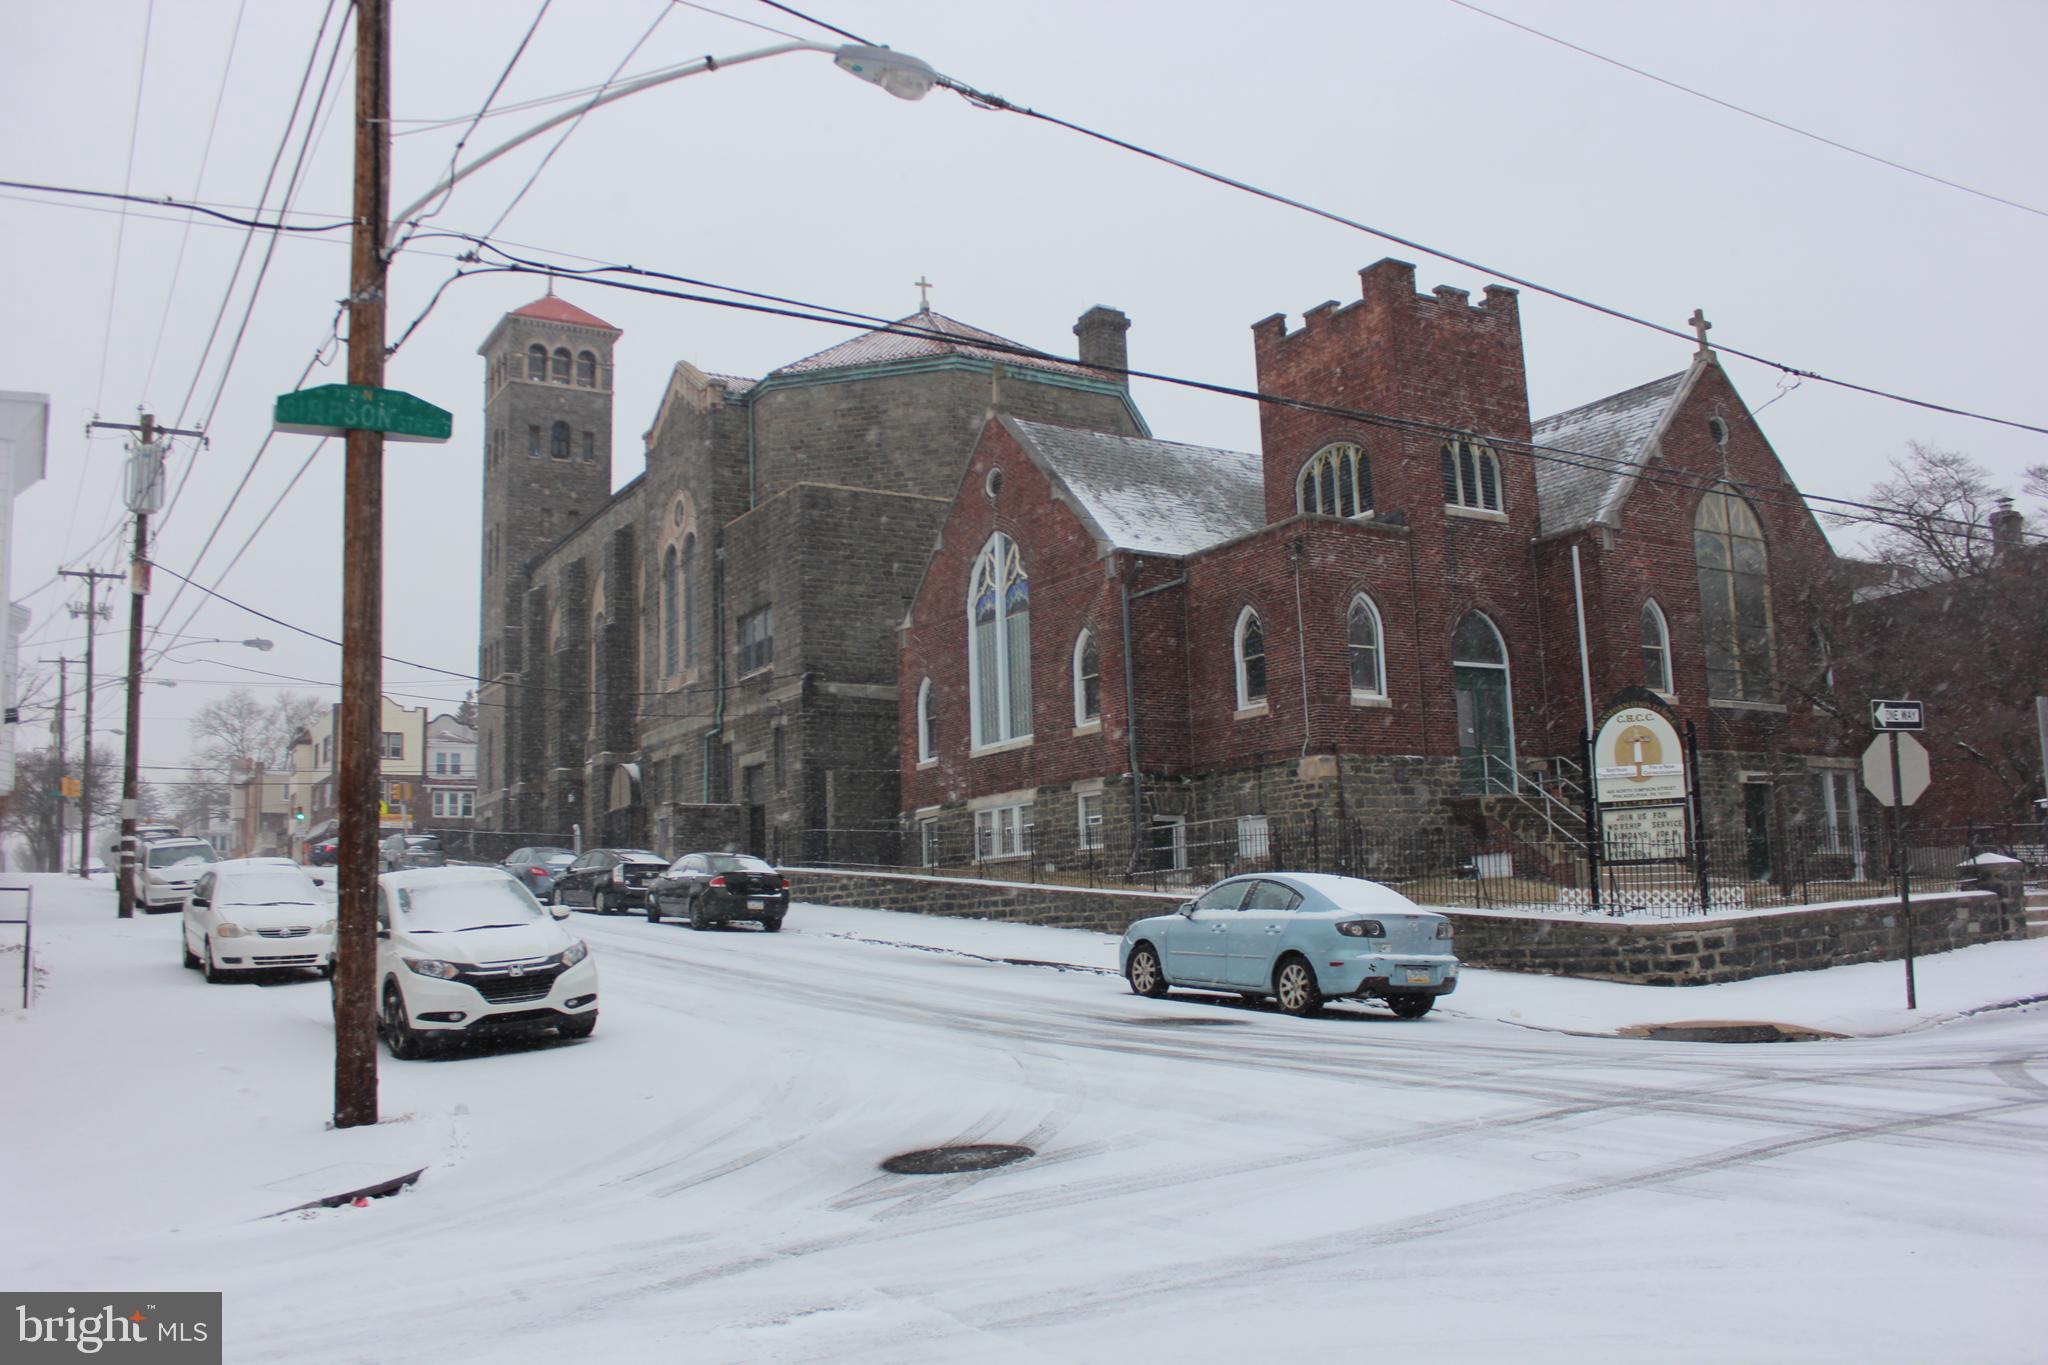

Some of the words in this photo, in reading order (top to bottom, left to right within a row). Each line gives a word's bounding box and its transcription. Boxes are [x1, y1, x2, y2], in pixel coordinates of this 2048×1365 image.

[1638, 812, 1647, 820] US
[1653, 811, 1667, 819] FOR
[1652, 820, 1683, 828] SERVICE
